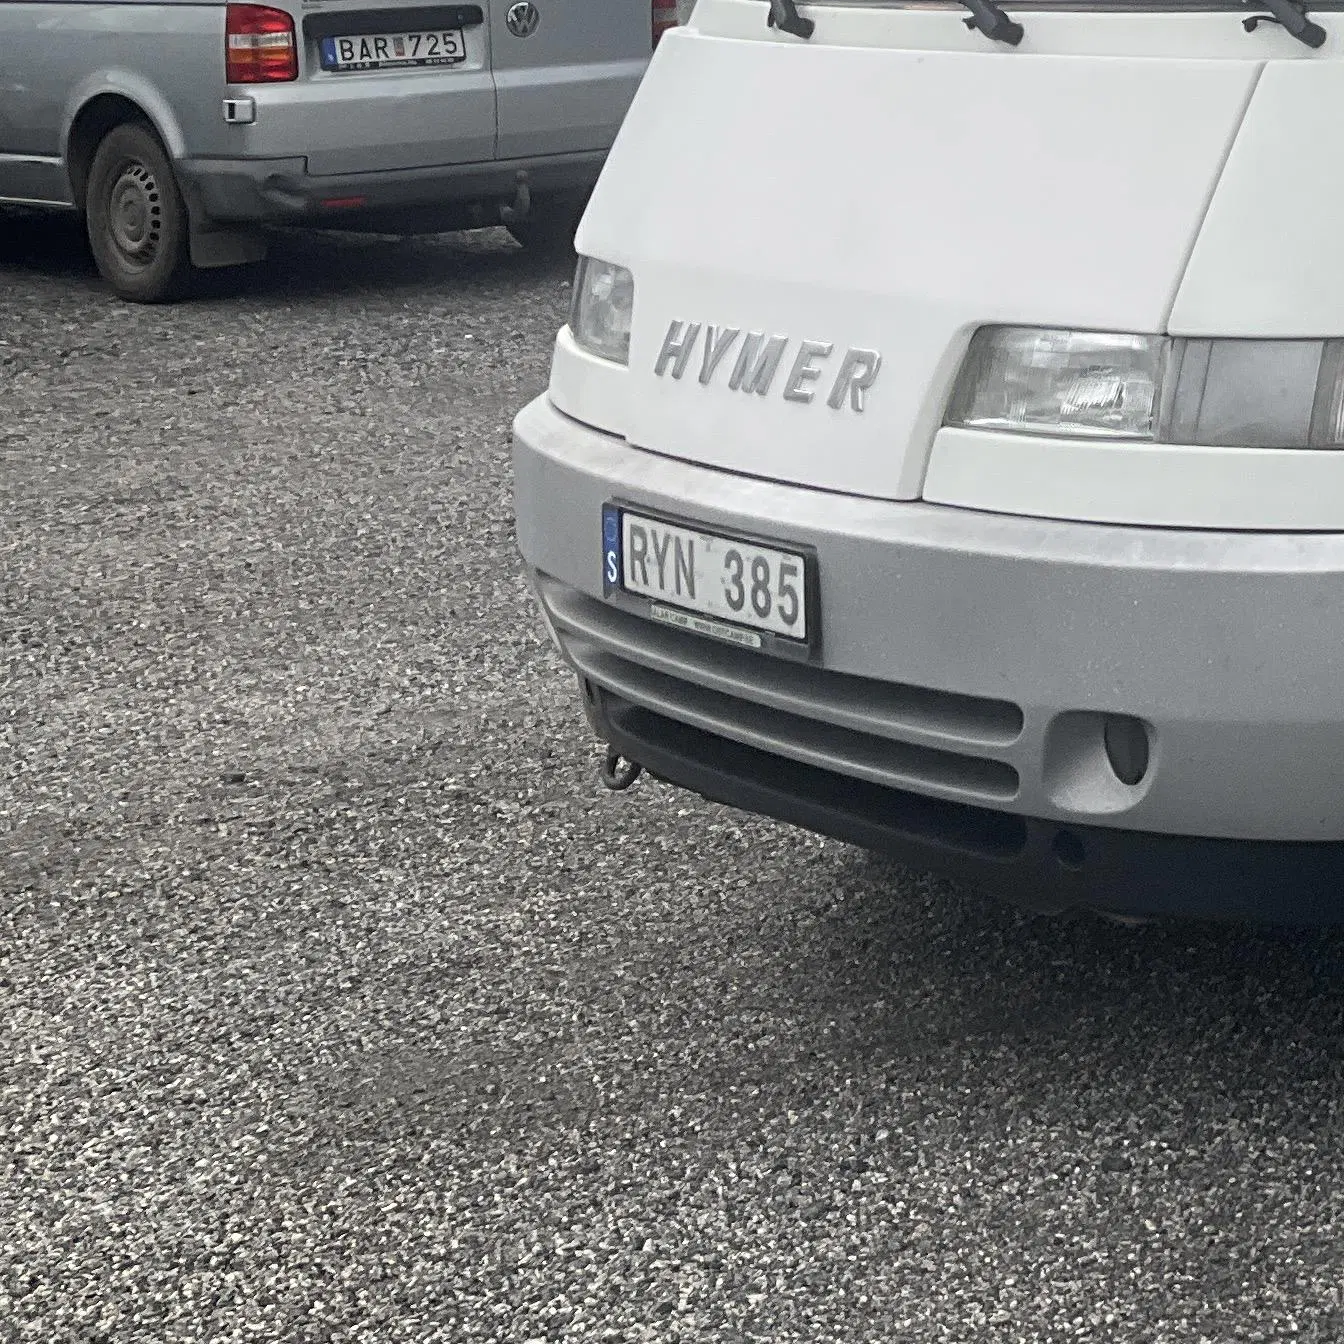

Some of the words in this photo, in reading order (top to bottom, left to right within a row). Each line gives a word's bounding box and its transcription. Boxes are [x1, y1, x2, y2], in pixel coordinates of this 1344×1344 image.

[339, 37, 390, 61] BAR
[408, 33, 457, 57] 725
[654, 319, 882, 413] HYMER
[607, 551, 617, 583] S
[629, 523, 696, 600] RYN
[724, 549, 799, 626] 385
